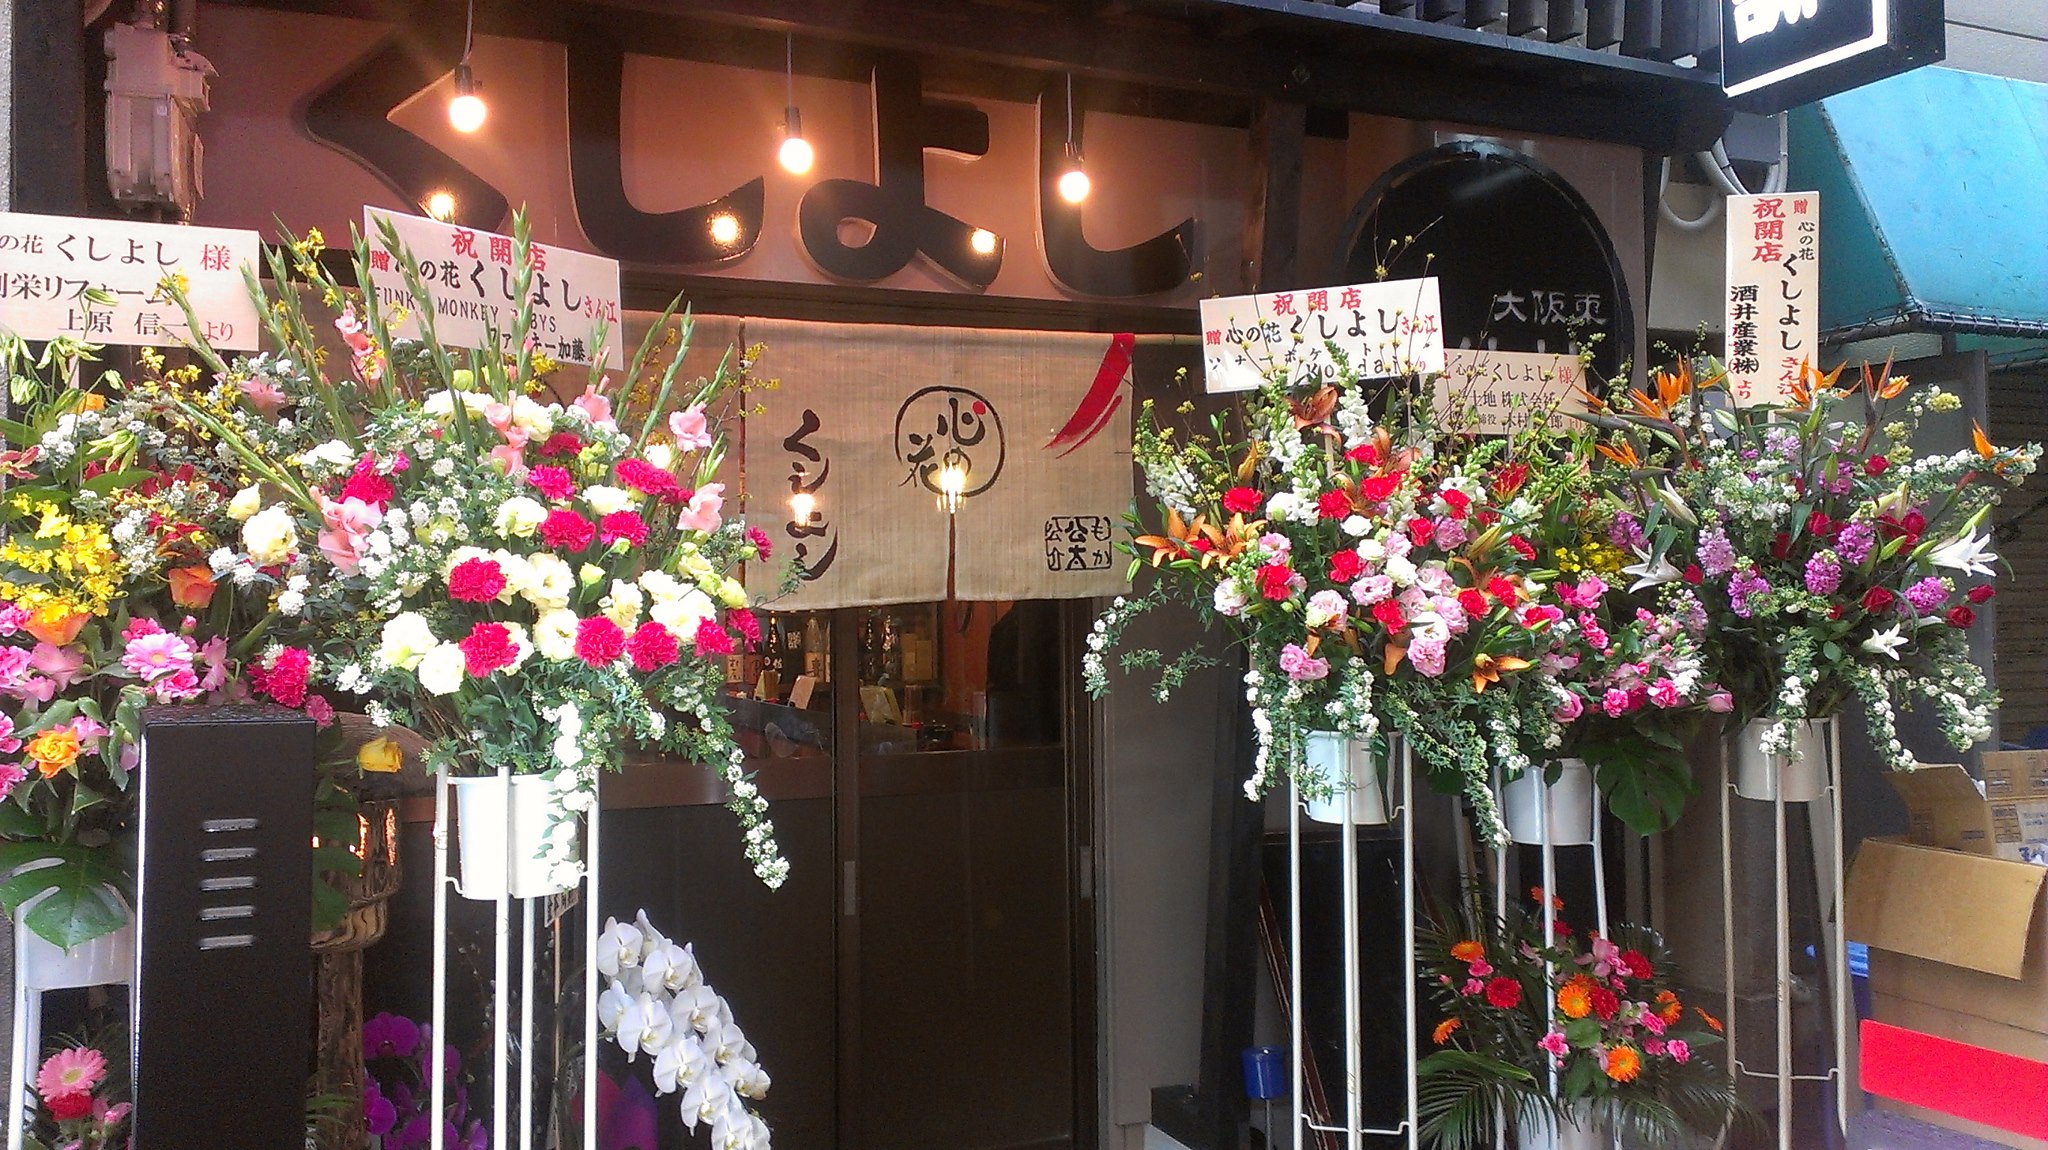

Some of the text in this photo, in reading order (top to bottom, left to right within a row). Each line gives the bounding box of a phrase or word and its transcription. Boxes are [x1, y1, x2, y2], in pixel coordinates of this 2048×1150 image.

[303, 35, 1197, 298] くしよし
[451, 227, 547, 272] 祝開店
[1751, 198, 1786, 263] 祝開店
[1798, 221, 1815, 261] 心の花
[57, 232, 180, 266] くしよし
[200, 244, 231, 271] 様
[470, 260, 582, 312] くしよし
[1273, 287, 1362, 317] 祝開店
[1778, 253, 1803, 351] くしよし
[374, 287, 557, 333] FUNK MONKEY BYS
[1290, 307, 1398, 340] くしよし
[204, 321, 234, 342] より
[490, 327, 586, 363] ファキー加藤
[1209, 342, 1372, 370] ソナーポケト
[1559, 366, 1574, 385] 様
[1737, 379, 1753, 400] より
